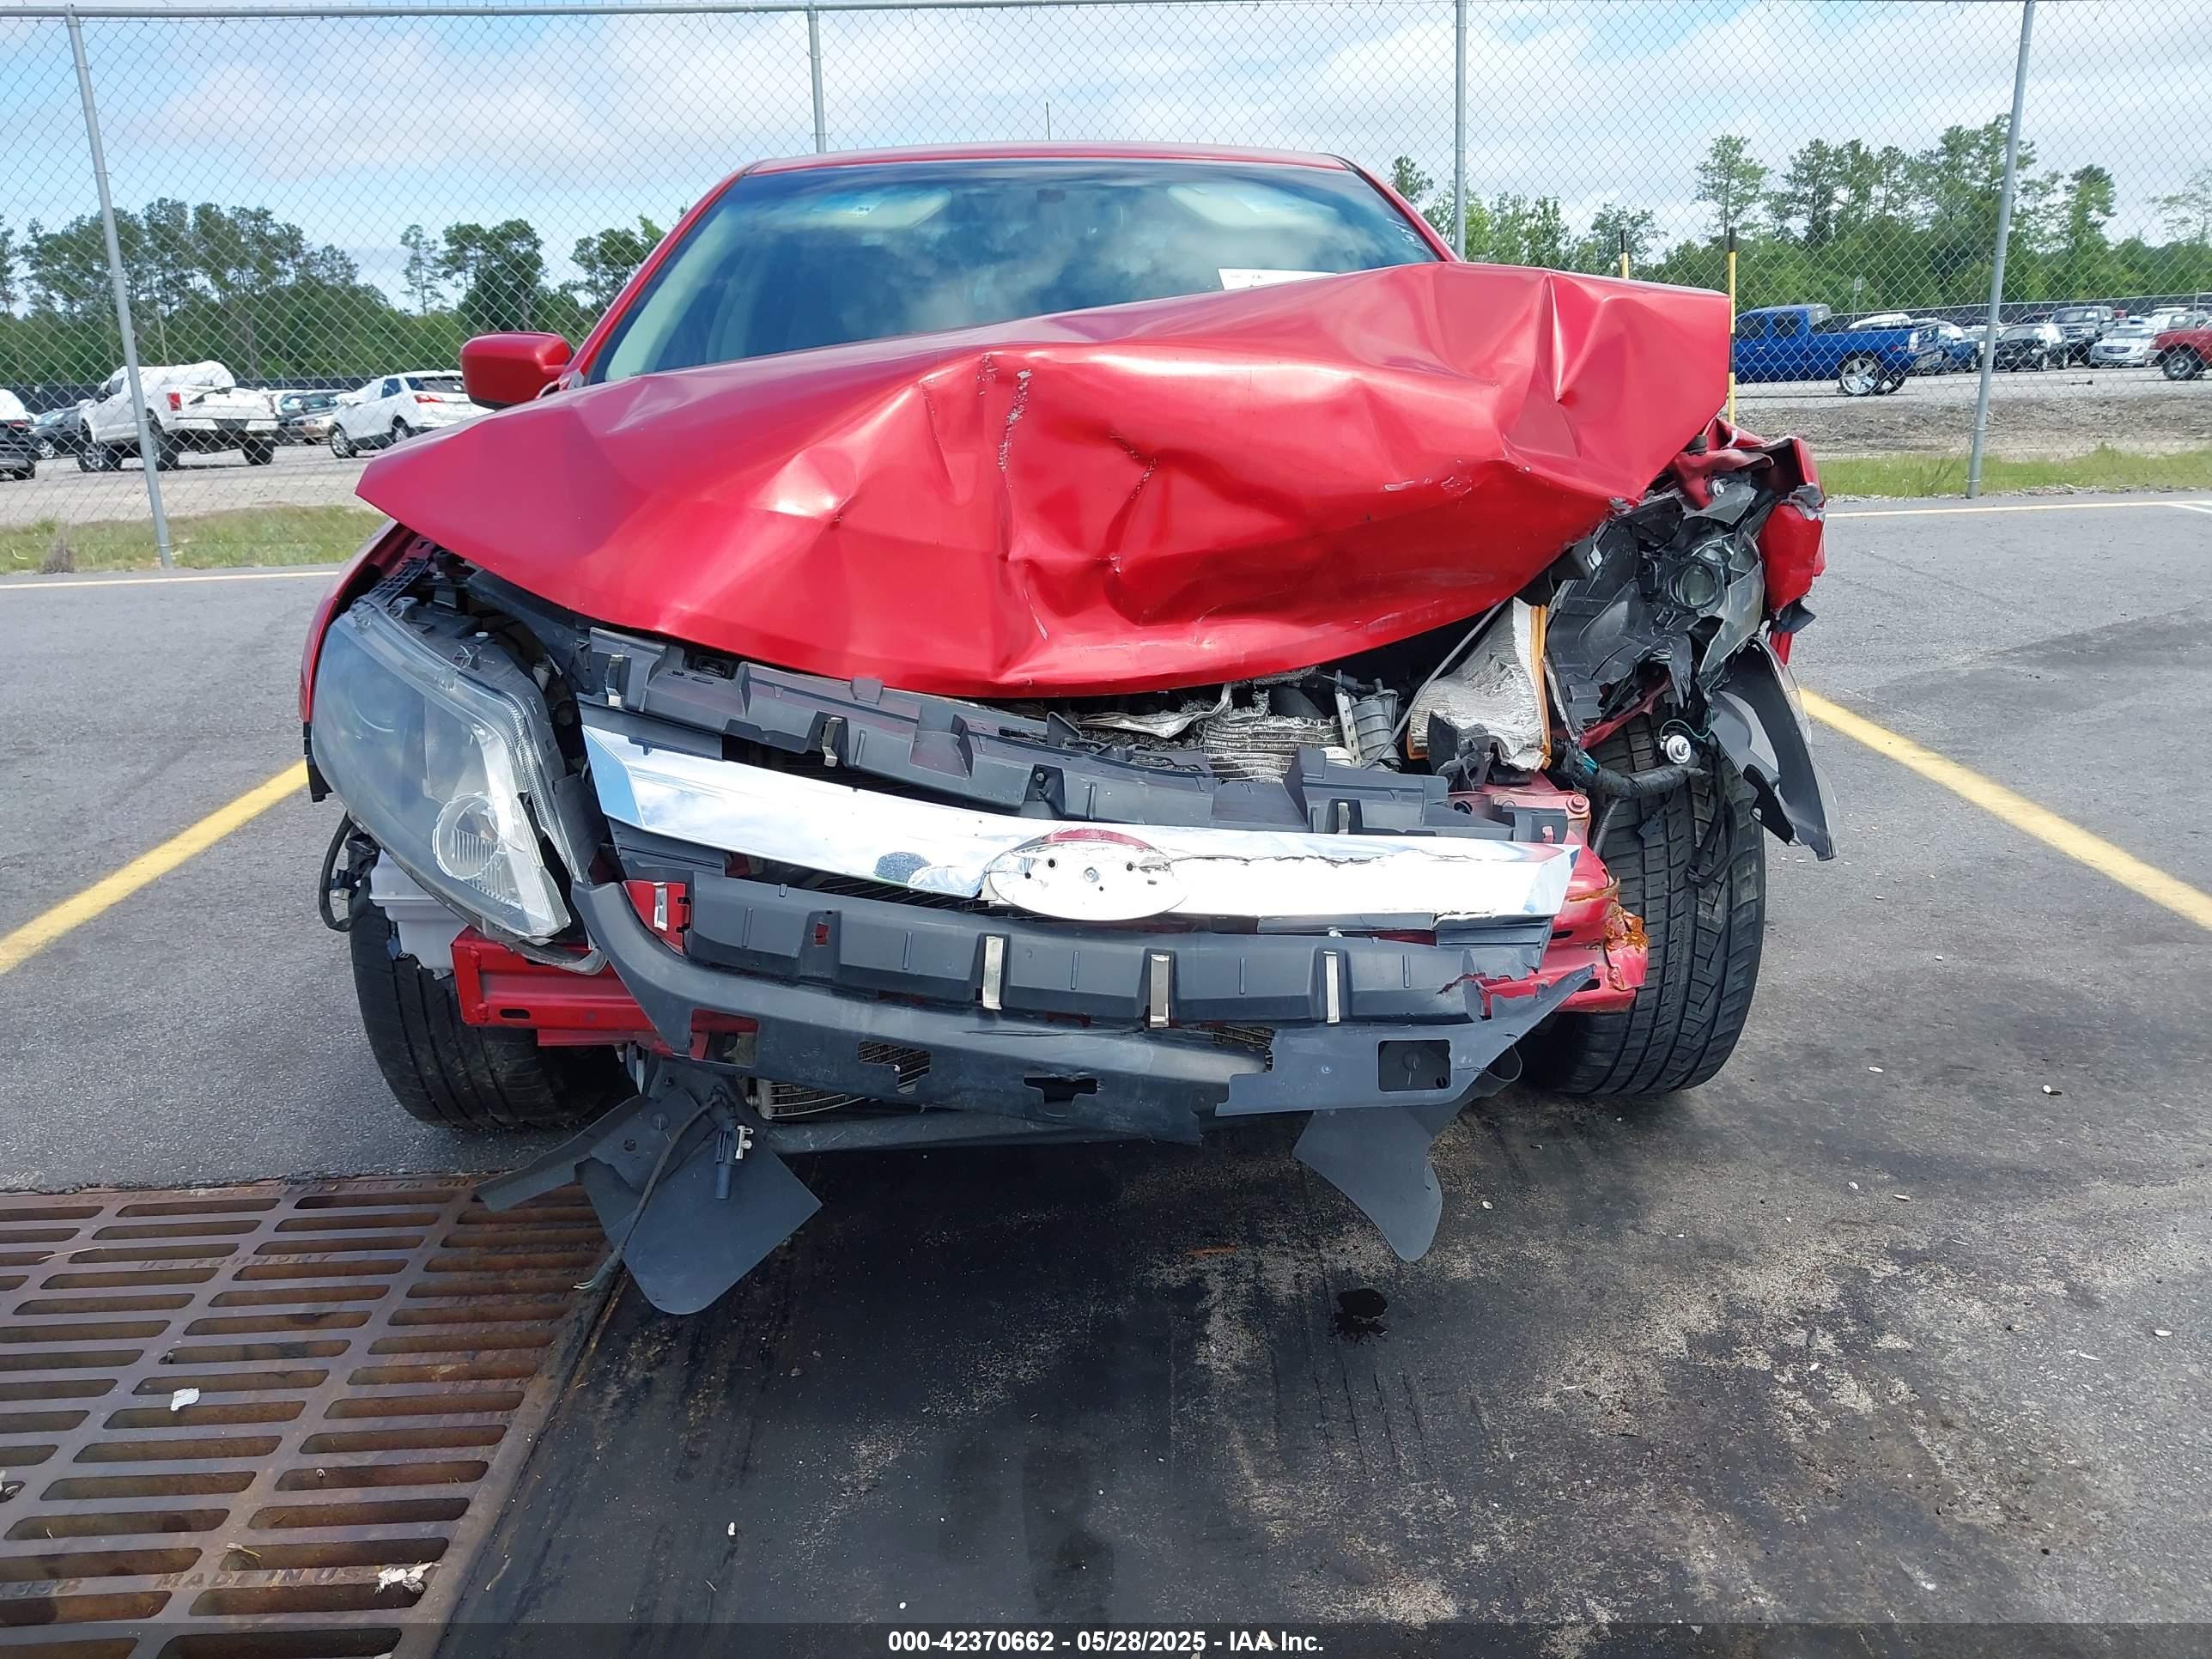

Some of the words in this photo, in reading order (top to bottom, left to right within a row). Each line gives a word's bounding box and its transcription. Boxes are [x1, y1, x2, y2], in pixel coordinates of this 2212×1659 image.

[138, 1260, 176, 1270] US
[189, 1254, 335, 1268] FOUNDRY
[154, 1571, 251, 1589] MADE
[265, 1567, 307, 1585] IN
